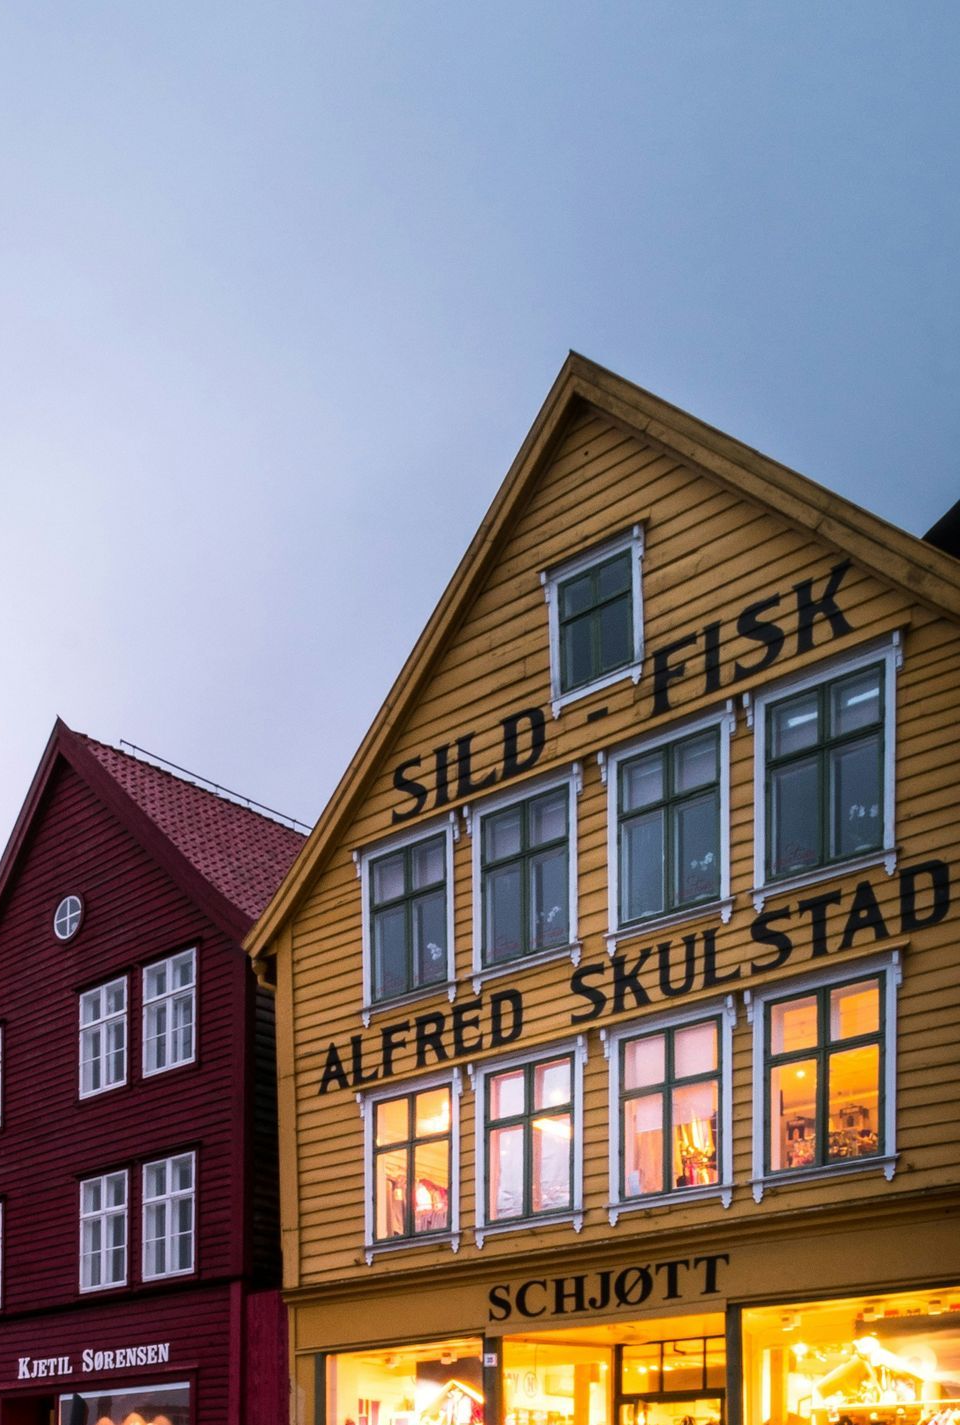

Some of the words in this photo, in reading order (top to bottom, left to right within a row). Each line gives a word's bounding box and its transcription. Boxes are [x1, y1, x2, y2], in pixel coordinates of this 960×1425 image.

[391, 706, 546, 824] SILD
[650, 562, 853, 718] FISK
[317, 988, 524, 1095] ALFRED
[570, 859, 951, 1024] SKULSTAD
[488, 1253, 730, 1322] SCHJØTT
